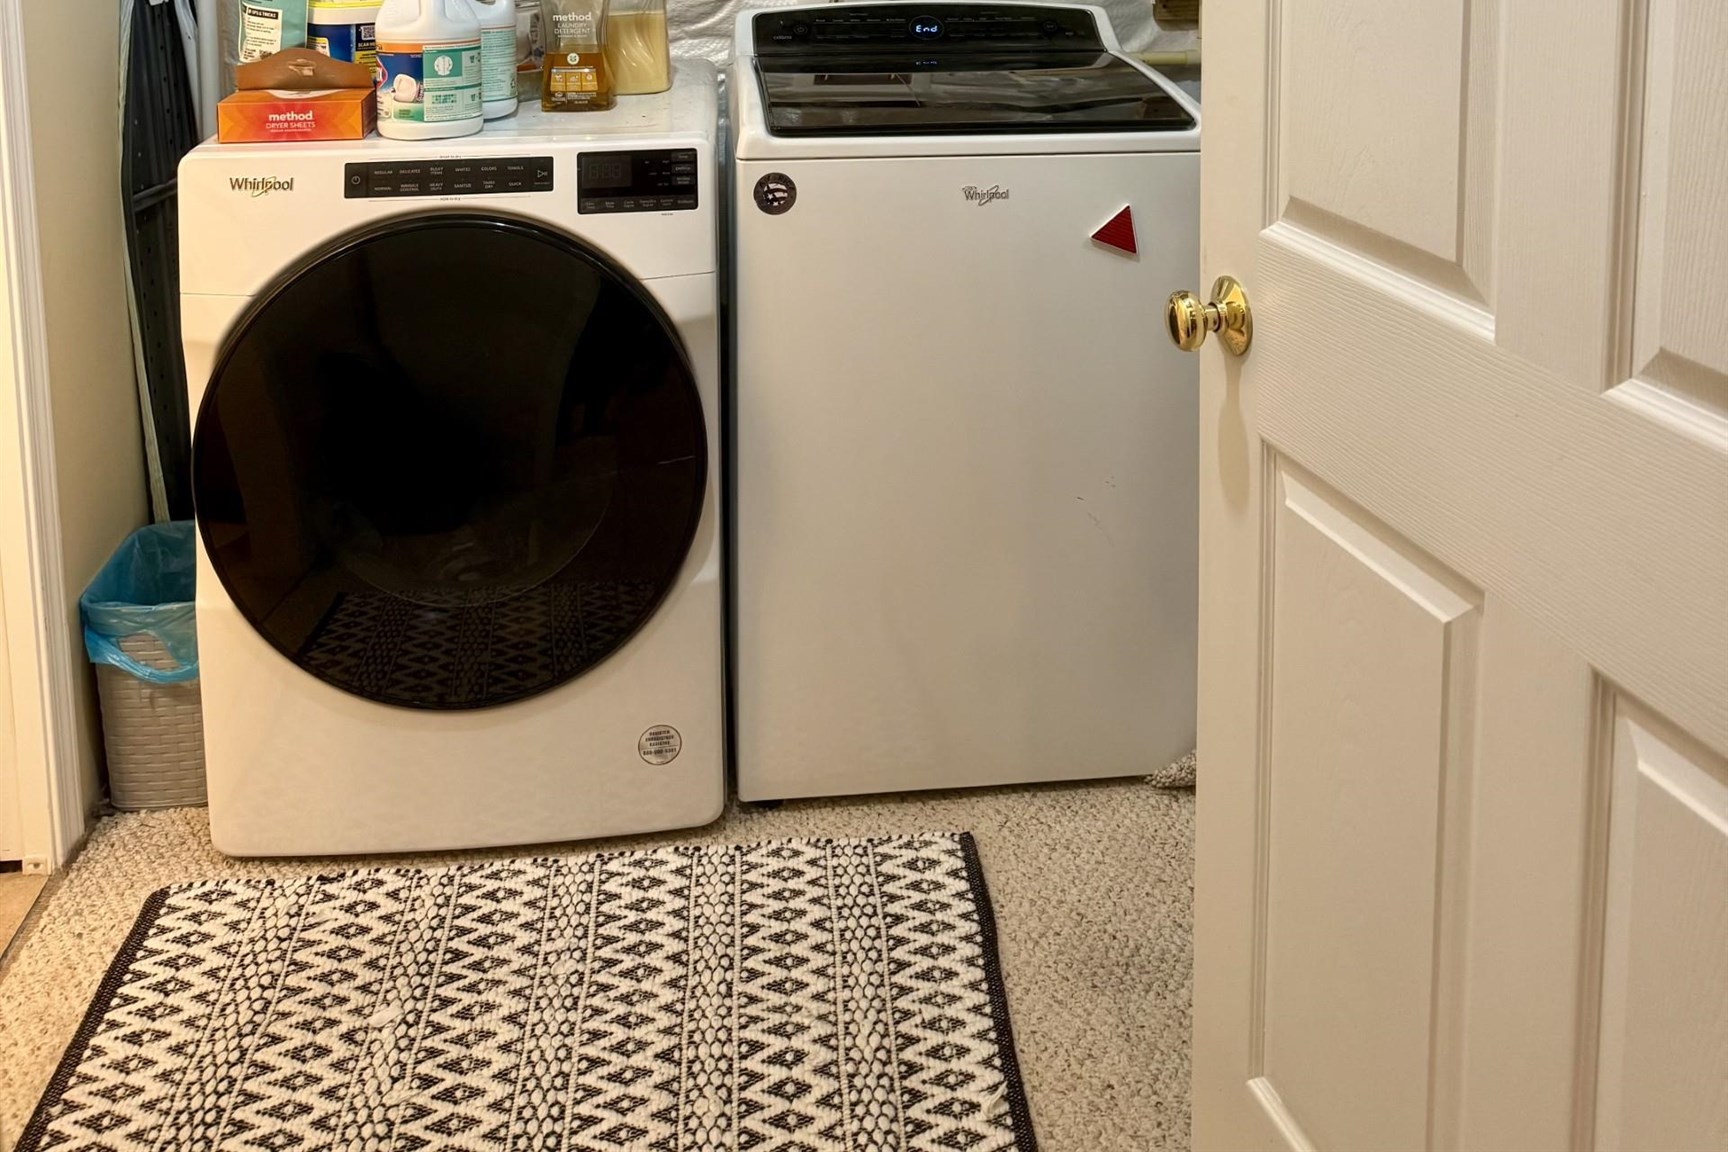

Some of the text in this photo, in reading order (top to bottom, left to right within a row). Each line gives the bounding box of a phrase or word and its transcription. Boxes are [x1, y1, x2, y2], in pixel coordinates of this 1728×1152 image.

[552, 12, 592, 21] method
[915, 24, 938, 33] End
[268, 110, 313, 121] method
[229, 176, 294, 194] Whirlpool
[963, 186, 1009, 203] Whirlpool
